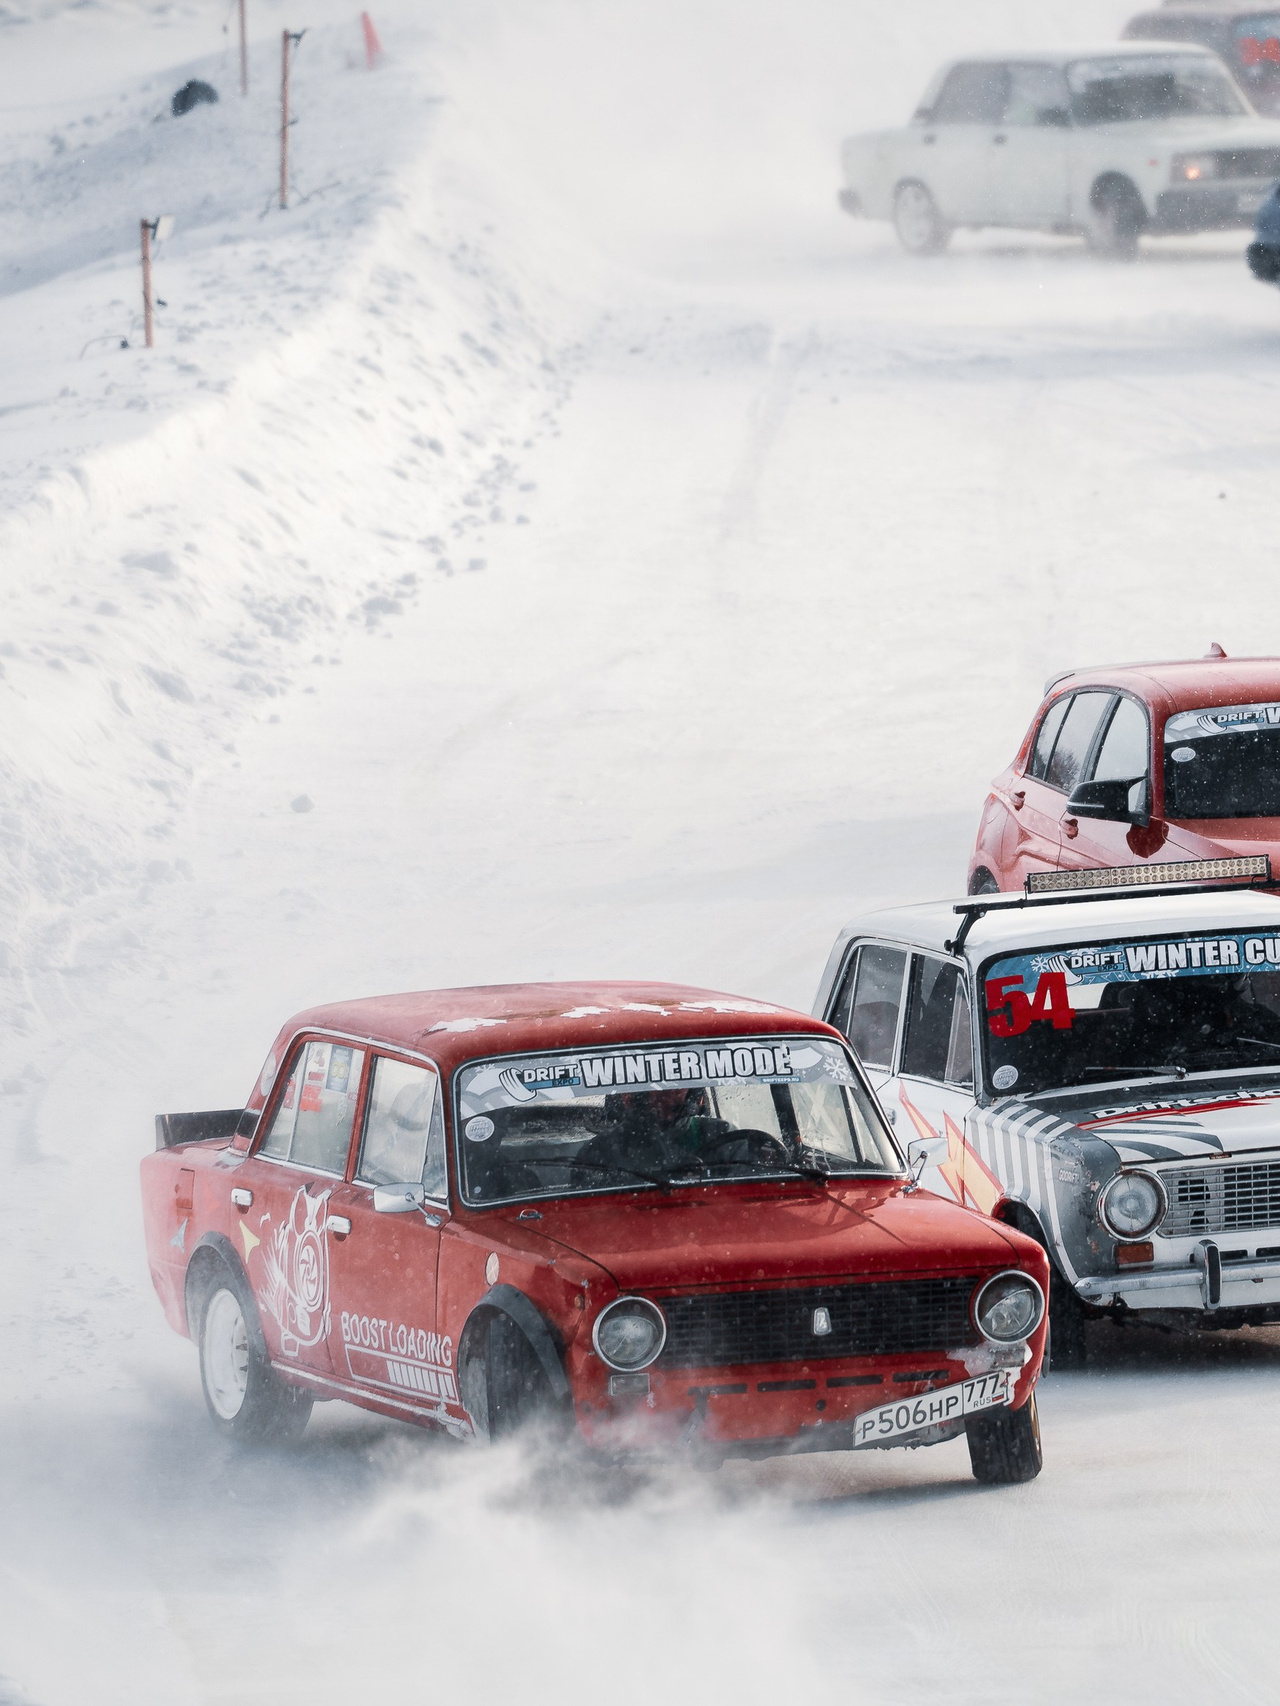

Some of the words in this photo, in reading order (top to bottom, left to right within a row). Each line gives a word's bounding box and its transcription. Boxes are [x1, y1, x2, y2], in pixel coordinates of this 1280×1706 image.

[1217, 710, 1264, 723] DRIFT
[1070, 951, 1122, 969] DRIFT
[1125, 938, 1241, 973] WINTER
[985, 971, 1077, 1038] 54
[523, 1063, 579, 1083] DRIFT
[580, 1049, 702, 1088] WINTER
[704, 1045, 794, 1080] MODE
[341, 1312, 387, 1350] BOOST
[387, 1322, 453, 1367] LOADING
[964, 1374, 1000, 1403] 777
[973, 1396, 992, 1408] RUS
